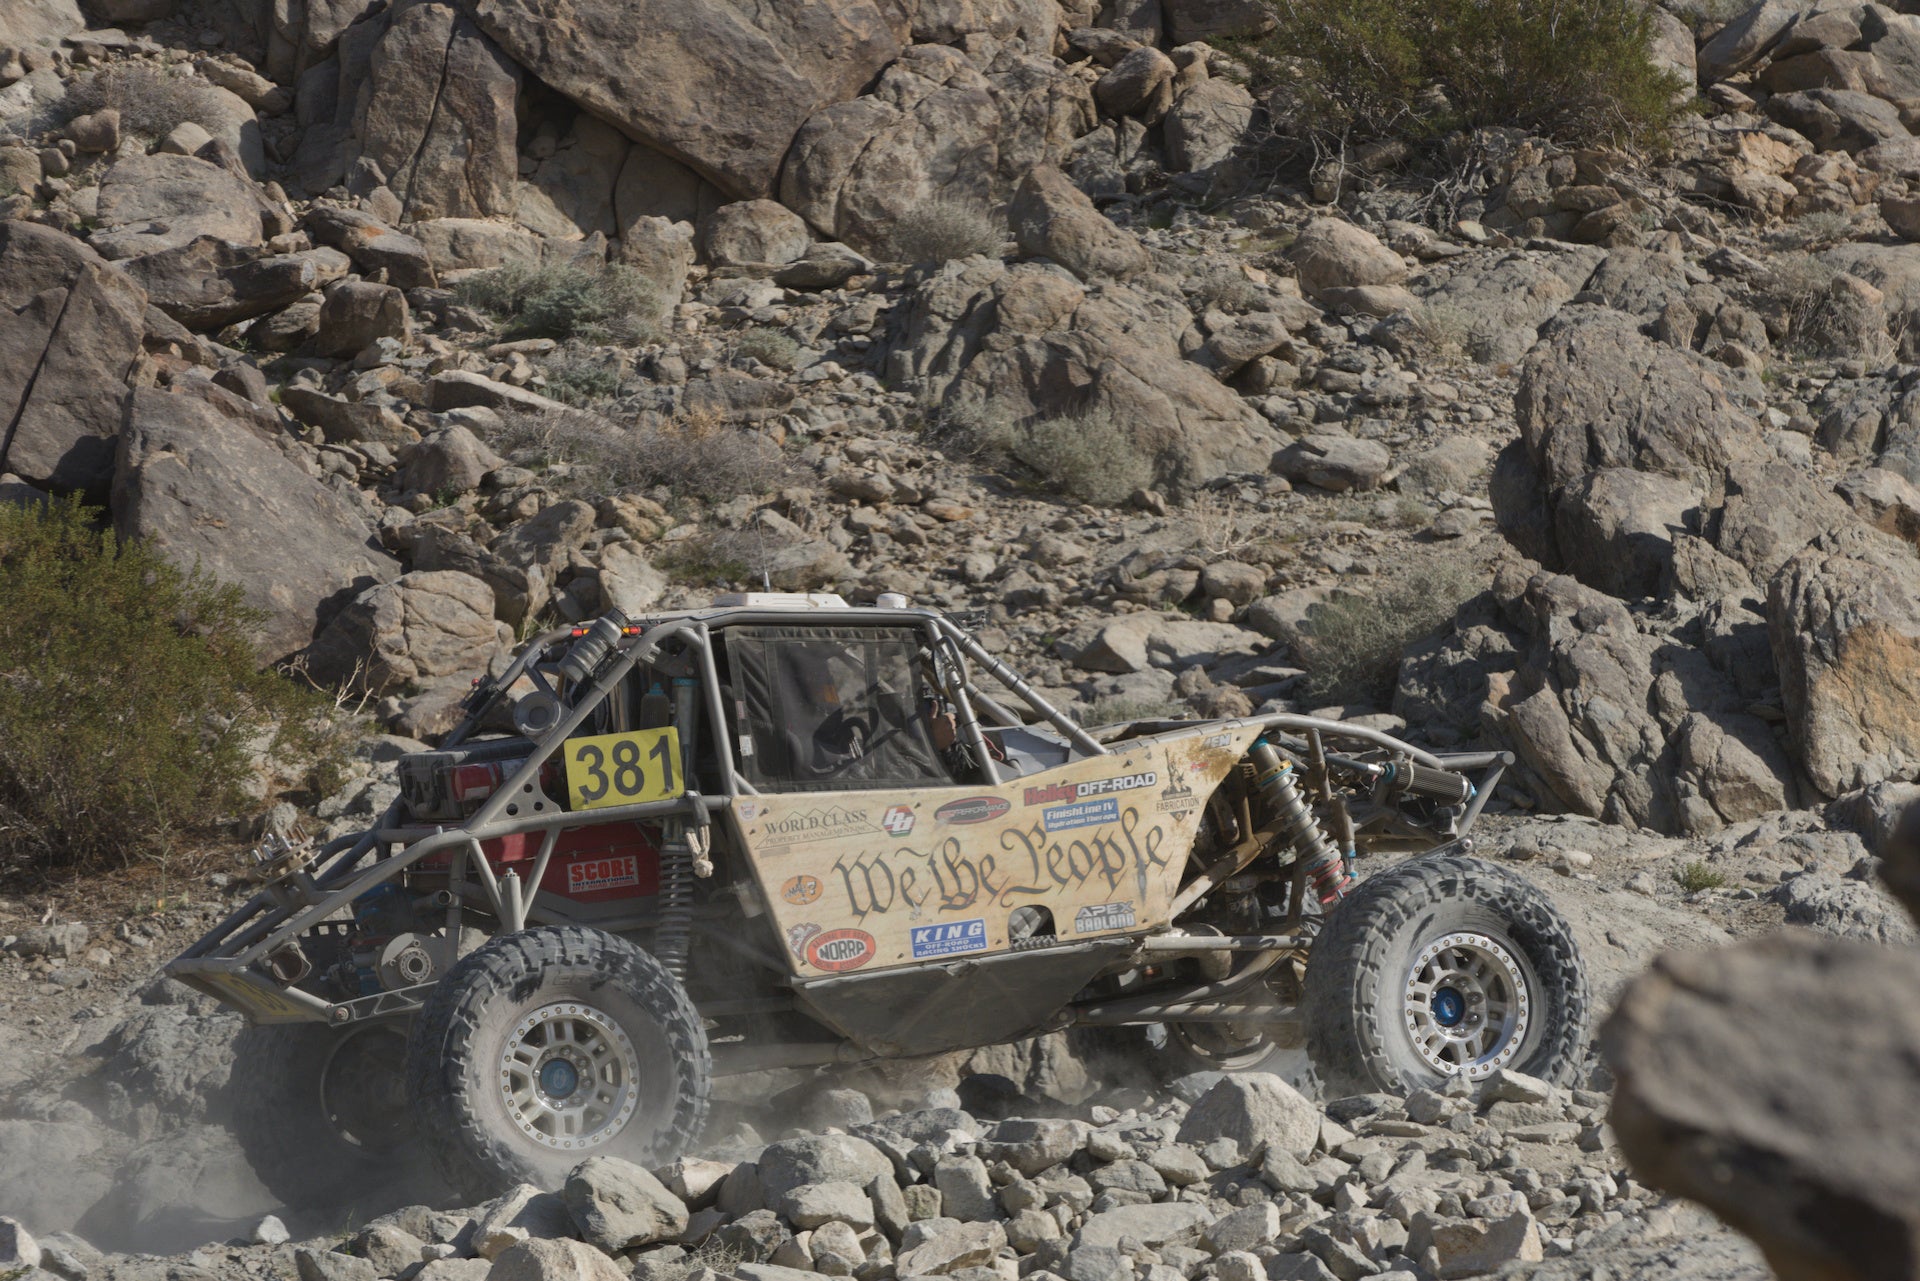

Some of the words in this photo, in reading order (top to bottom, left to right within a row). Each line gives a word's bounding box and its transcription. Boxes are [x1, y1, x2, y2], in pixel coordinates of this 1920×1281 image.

[576, 734, 674, 801] 381
[1024, 784, 1077, 805] Holley
[1077, 772, 1156, 796] OFF-ROAD
[954, 802, 1009, 816] PERFORMANCE
[1046, 805, 1102, 820] FinishLine
[1103, 801, 1114, 811] IV
[1156, 797, 1199, 811] FABRICATION
[765, 816, 819, 835] WORLD
[822, 809, 867, 828] CLASS
[1087, 813, 1117, 823] Therapy
[571, 858, 634, 882] SCORE
[831, 849, 931, 927] We
[926, 836, 1010, 914] the
[1000, 807, 1172, 908] People
[572, 876, 633, 887] INTERNATIONAL
[1077, 901, 1136, 918] APEX
[915, 922, 983, 943] KING
[1076, 913, 1135, 933] BADLAND
[819, 940, 865, 960] NORRA
[916, 948, 949, 957] RACING
[952, 943, 984, 952] SHOCKS
[925, 939, 969, 950] OFF-ROAD
